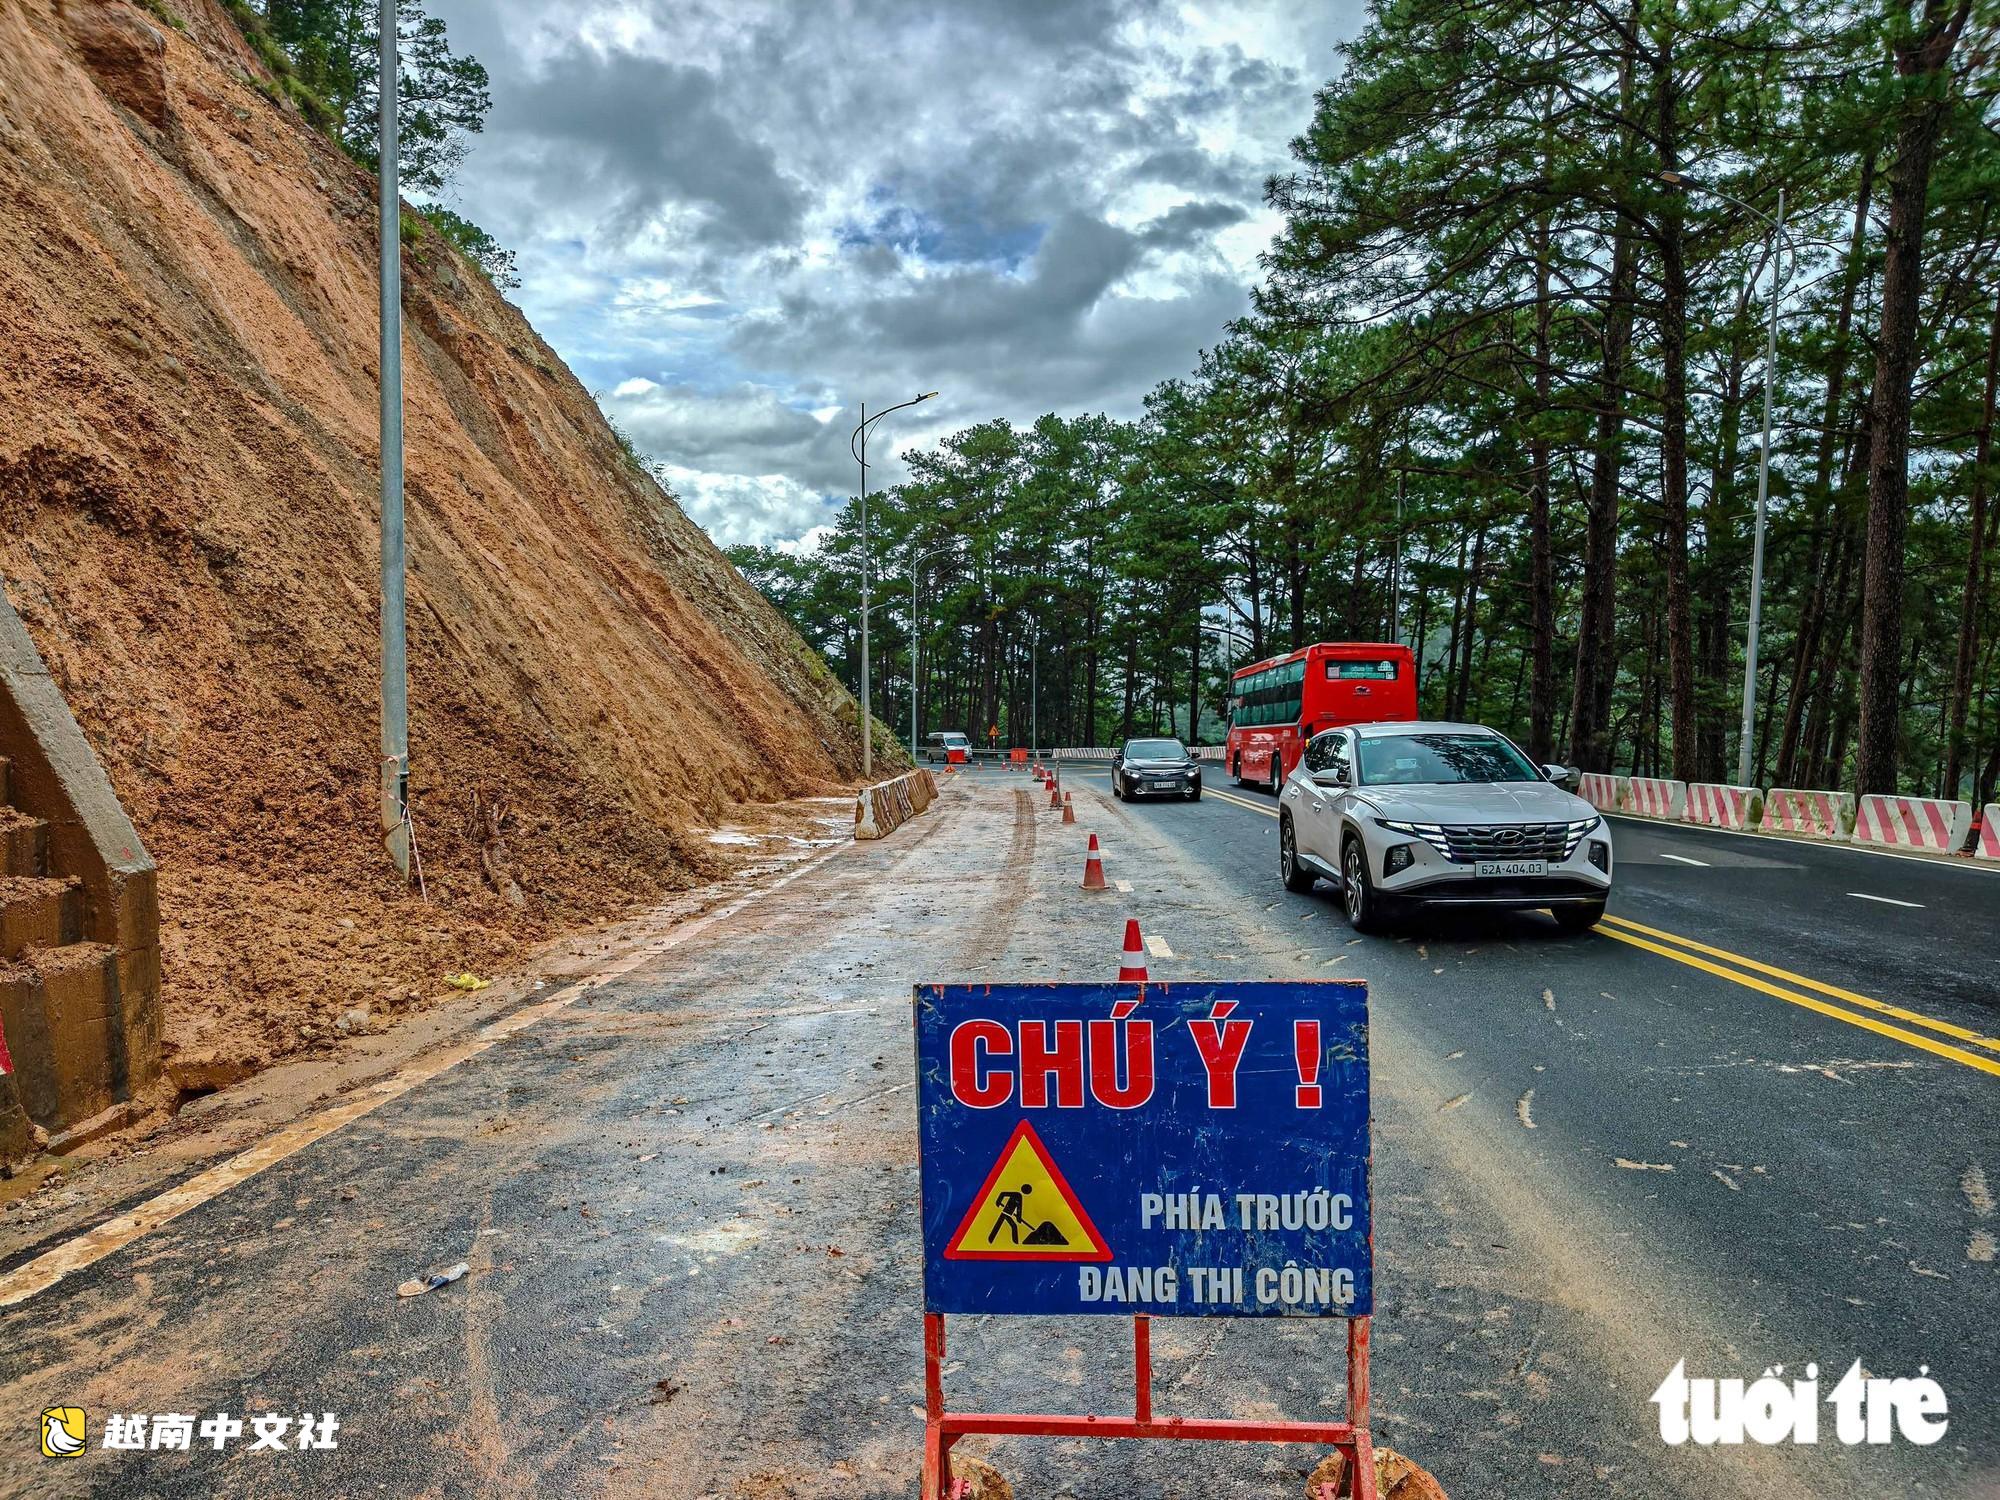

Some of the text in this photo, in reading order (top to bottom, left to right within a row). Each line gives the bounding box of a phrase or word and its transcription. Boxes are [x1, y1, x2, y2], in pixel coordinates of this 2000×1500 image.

[1481, 863, 1542, 875] 62A-404.03
[949, 1000, 1154, 1110] CHÚ
[1187, 1000, 1253, 1109] Ý
[1141, 1186, 1353, 1231] PHÍA TRƯỚC
[1078, 1260, 1355, 1305] ĐANG THI CÔNG
